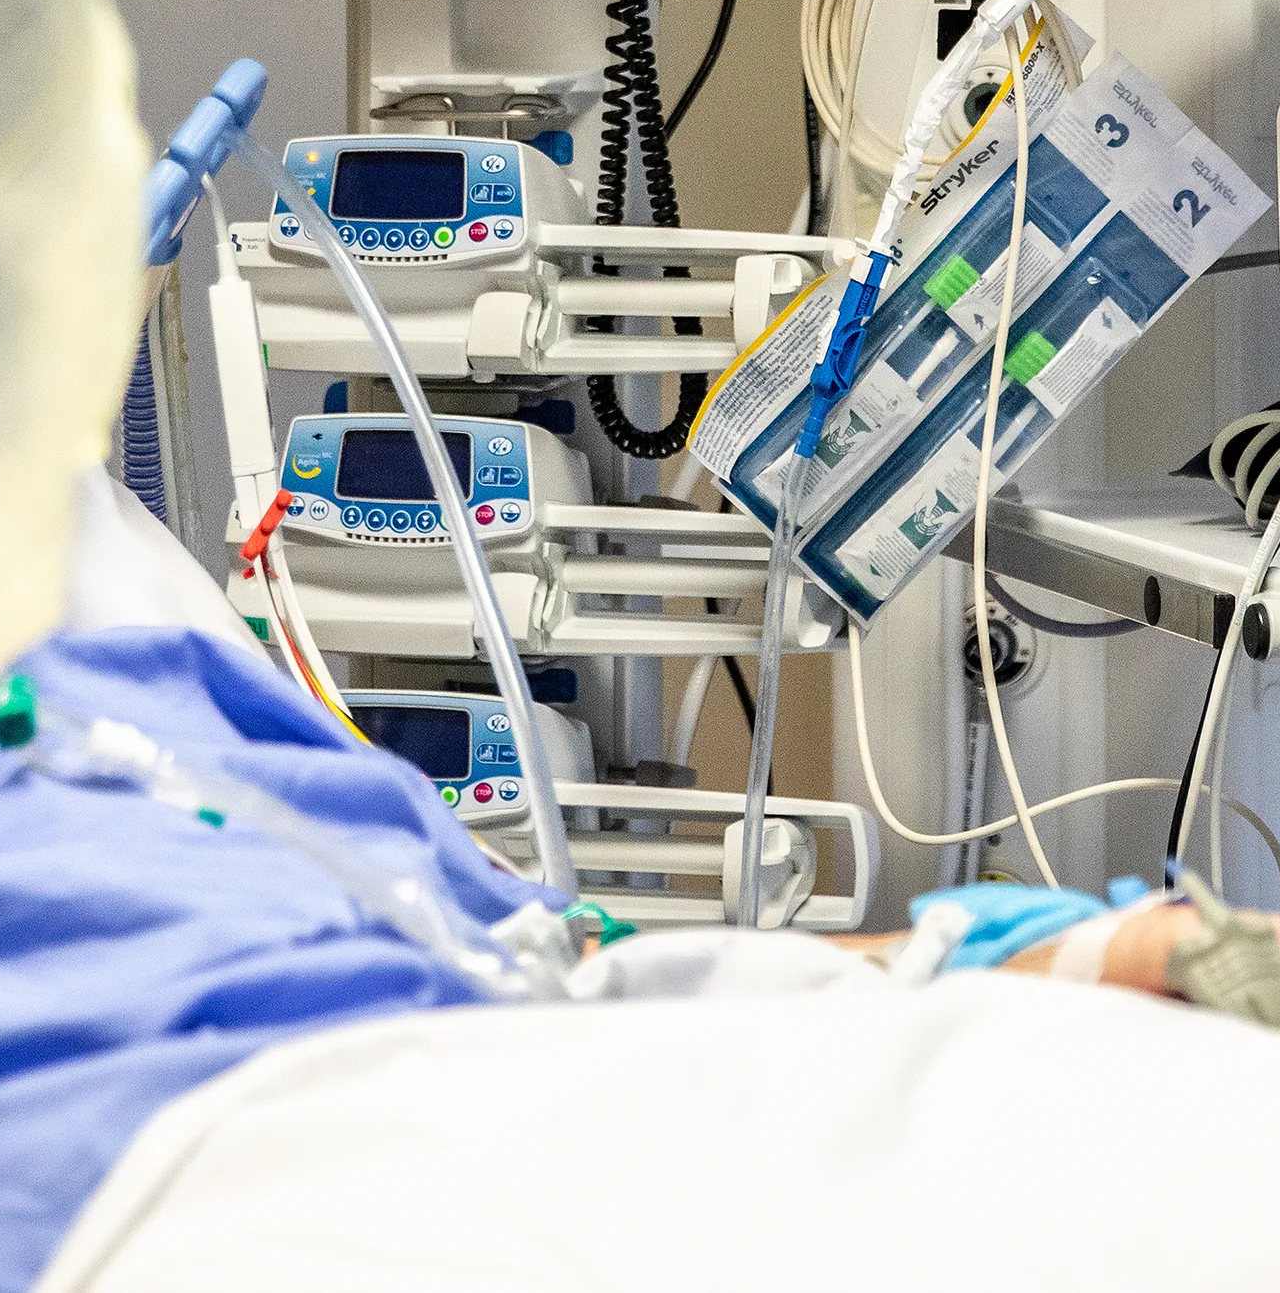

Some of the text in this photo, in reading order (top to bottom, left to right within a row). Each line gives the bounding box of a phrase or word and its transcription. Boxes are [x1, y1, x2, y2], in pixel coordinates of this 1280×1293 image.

[1095, 113, 1131, 149] 3
[920, 139, 1000, 216] stryker
[1173, 189, 1212, 229] 2
[470, 228, 487, 236] STOP
[297, 458, 320, 467] Agilia
[476, 511, 494, 519] STOP
[475, 789, 492, 797] STOP
